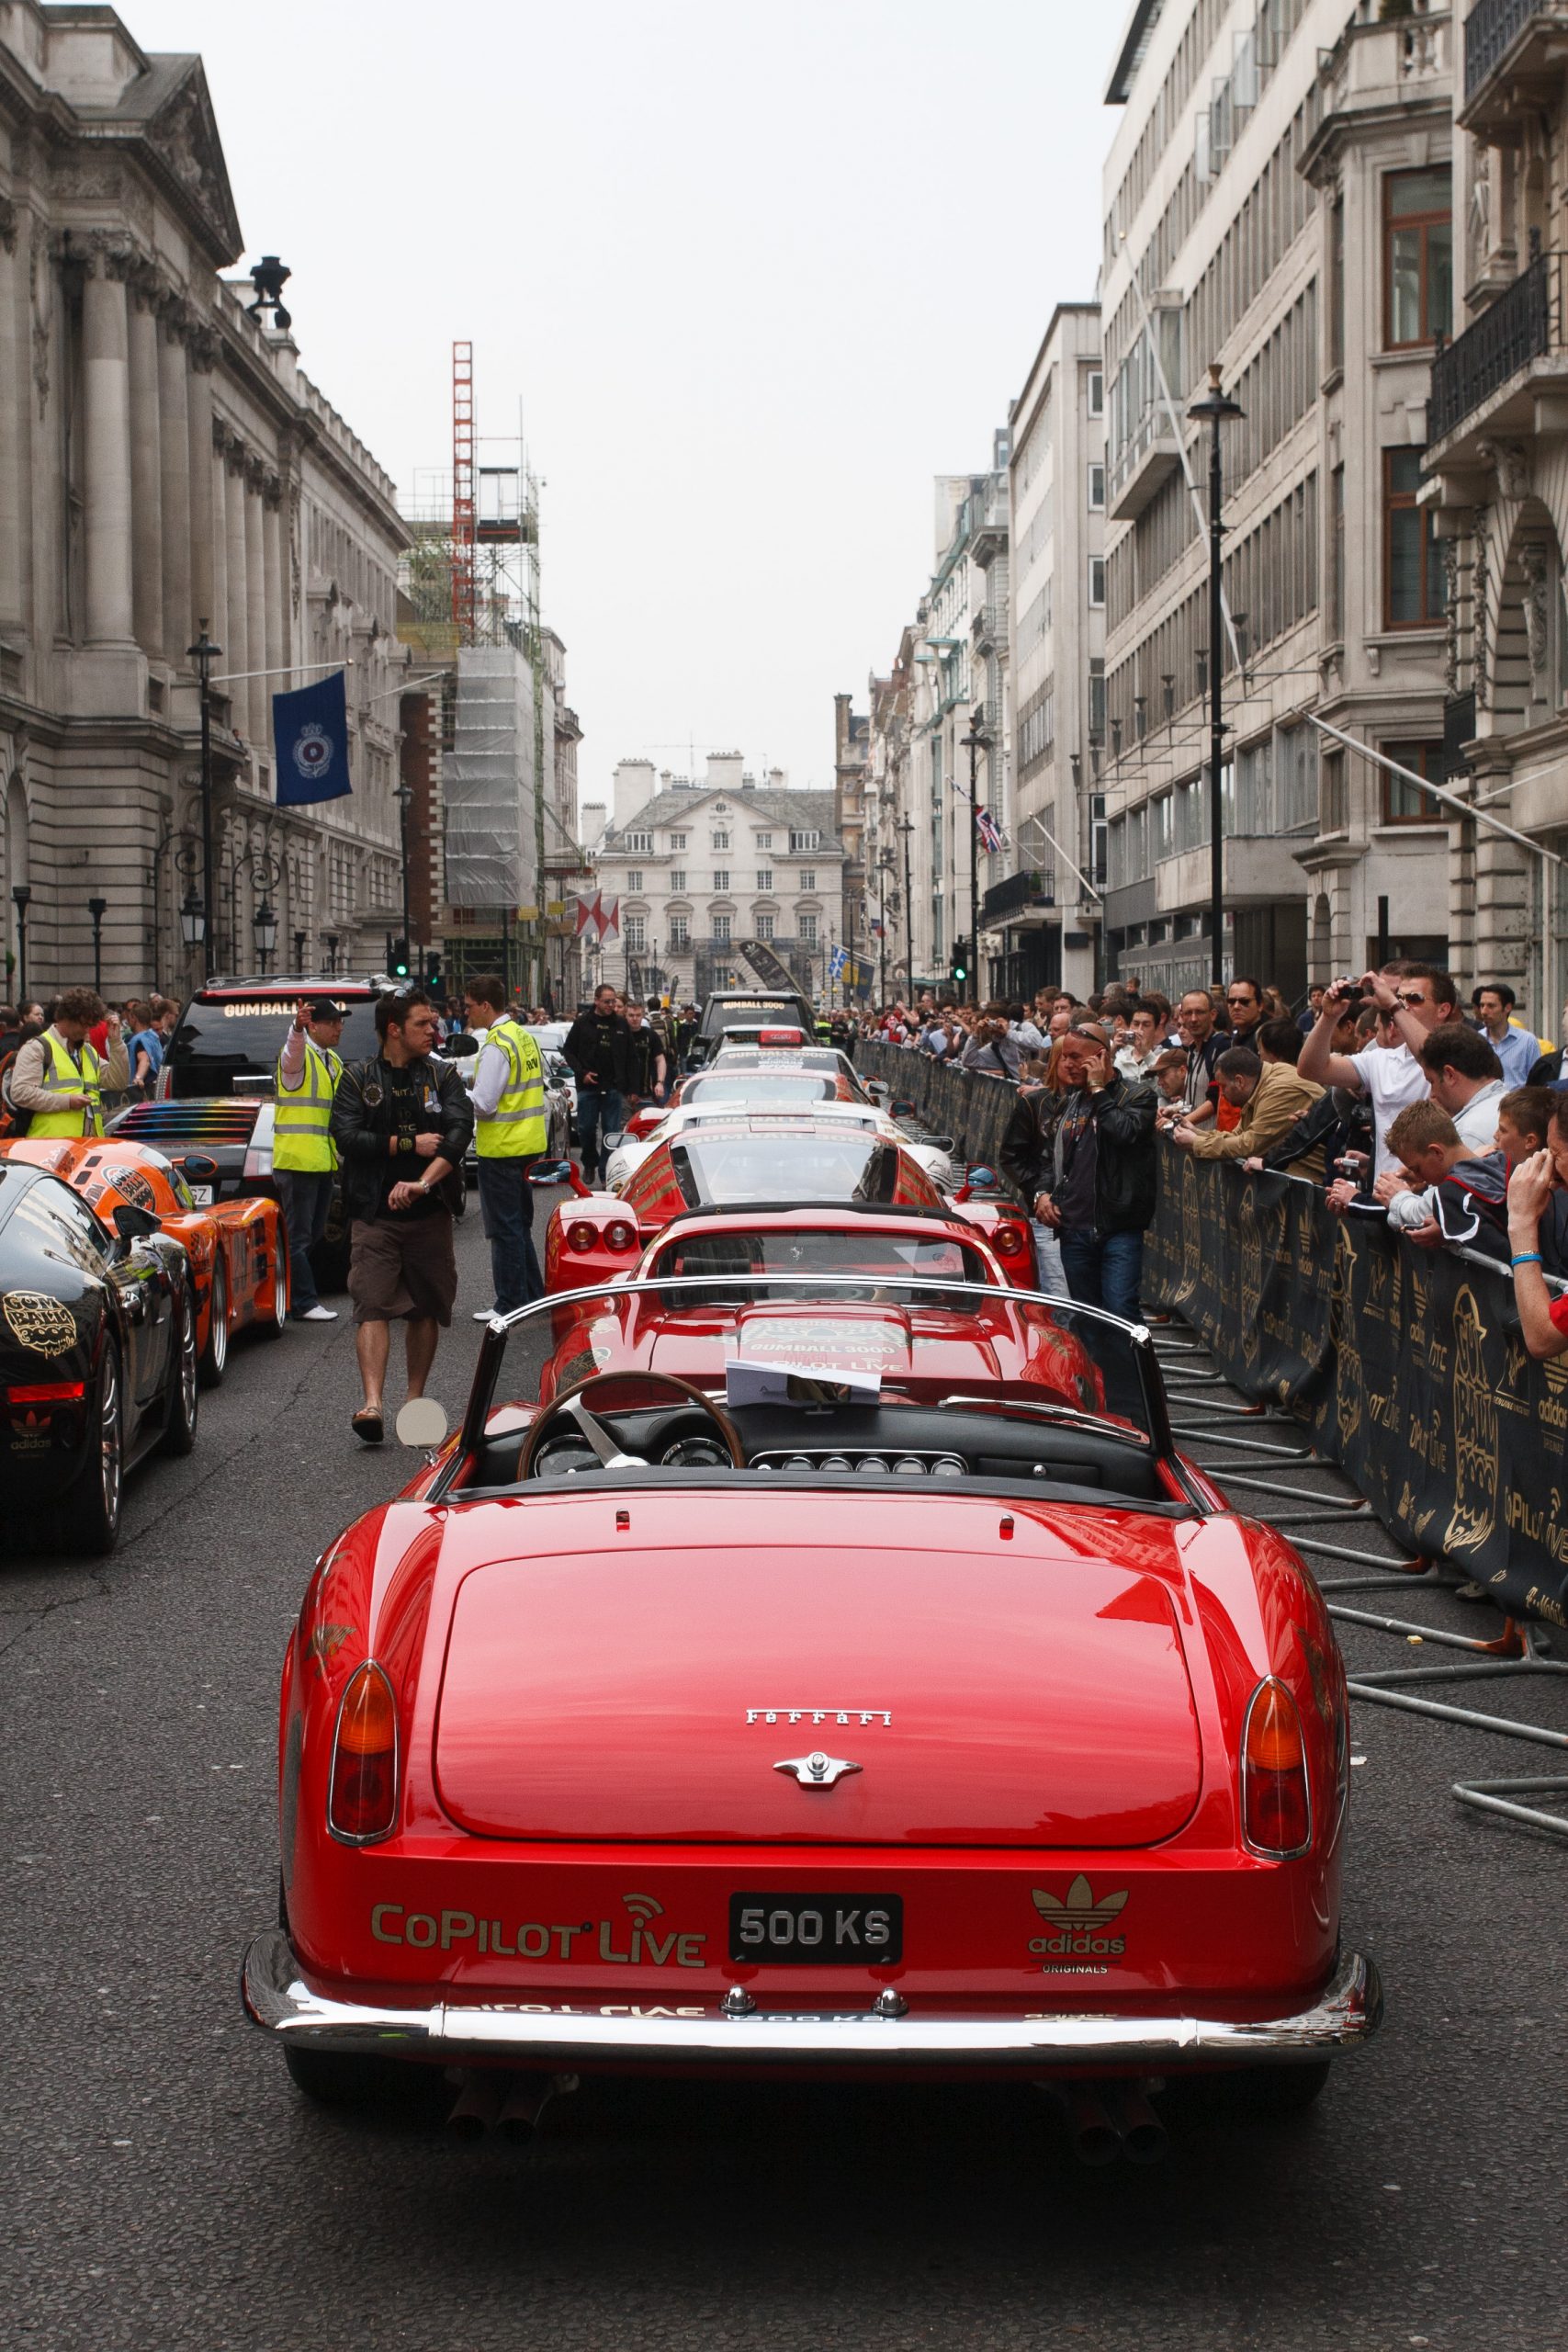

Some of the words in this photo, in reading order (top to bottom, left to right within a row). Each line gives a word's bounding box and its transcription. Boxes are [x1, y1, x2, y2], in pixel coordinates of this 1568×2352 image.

[224, 1002, 299, 1017] GUMBALL
[722, 1001, 761, 1010] GUMBALL
[762, 1001, 784, 1010] 3000
[750, 1343, 840, 1353] GUMBALL
[844, 1344, 896, 1354] 3000
[11, 1438, 52, 1450] adidas
[746, 1709, 892, 1726] Ferrari
[739, 1909, 824, 1945] 500
[835, 1910, 891, 1945] KS
[1028, 1933, 1125, 1955] adidas
[1042, 1963, 1108, 1974] ORIGINALS
